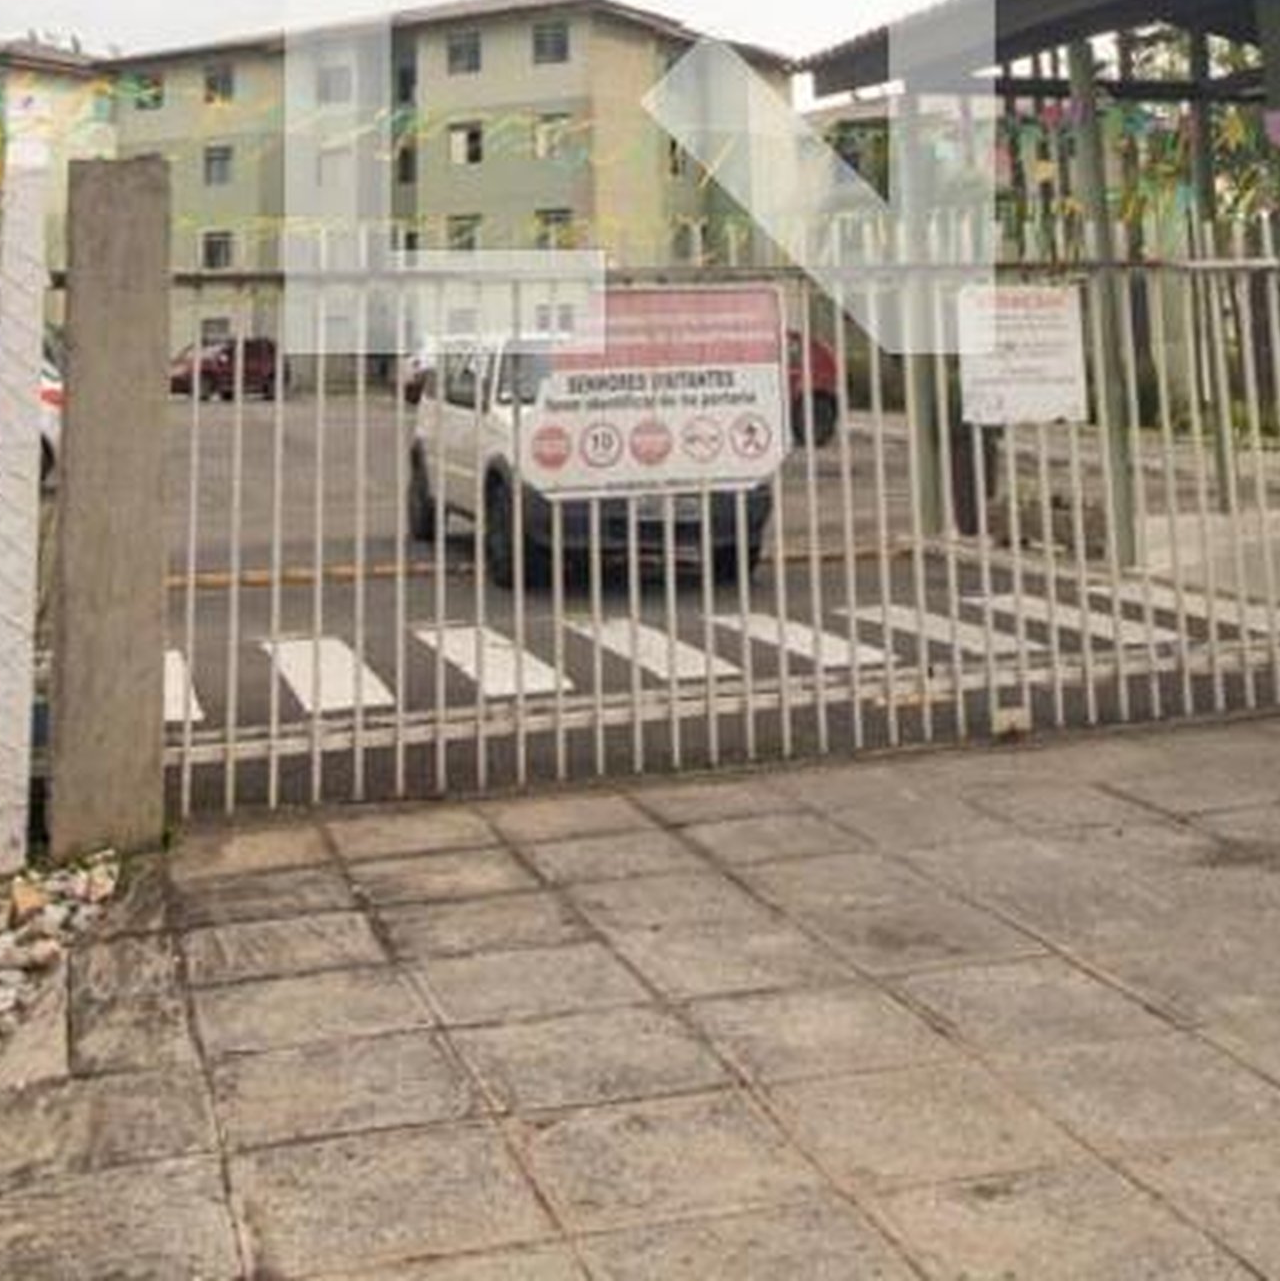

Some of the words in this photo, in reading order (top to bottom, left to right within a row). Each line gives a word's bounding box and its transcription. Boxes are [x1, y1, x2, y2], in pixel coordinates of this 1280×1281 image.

[567, 372, 646, 394] SENHORES
[651, 370, 733, 390] VISITANTES
[593, 432, 614, 450] 10
